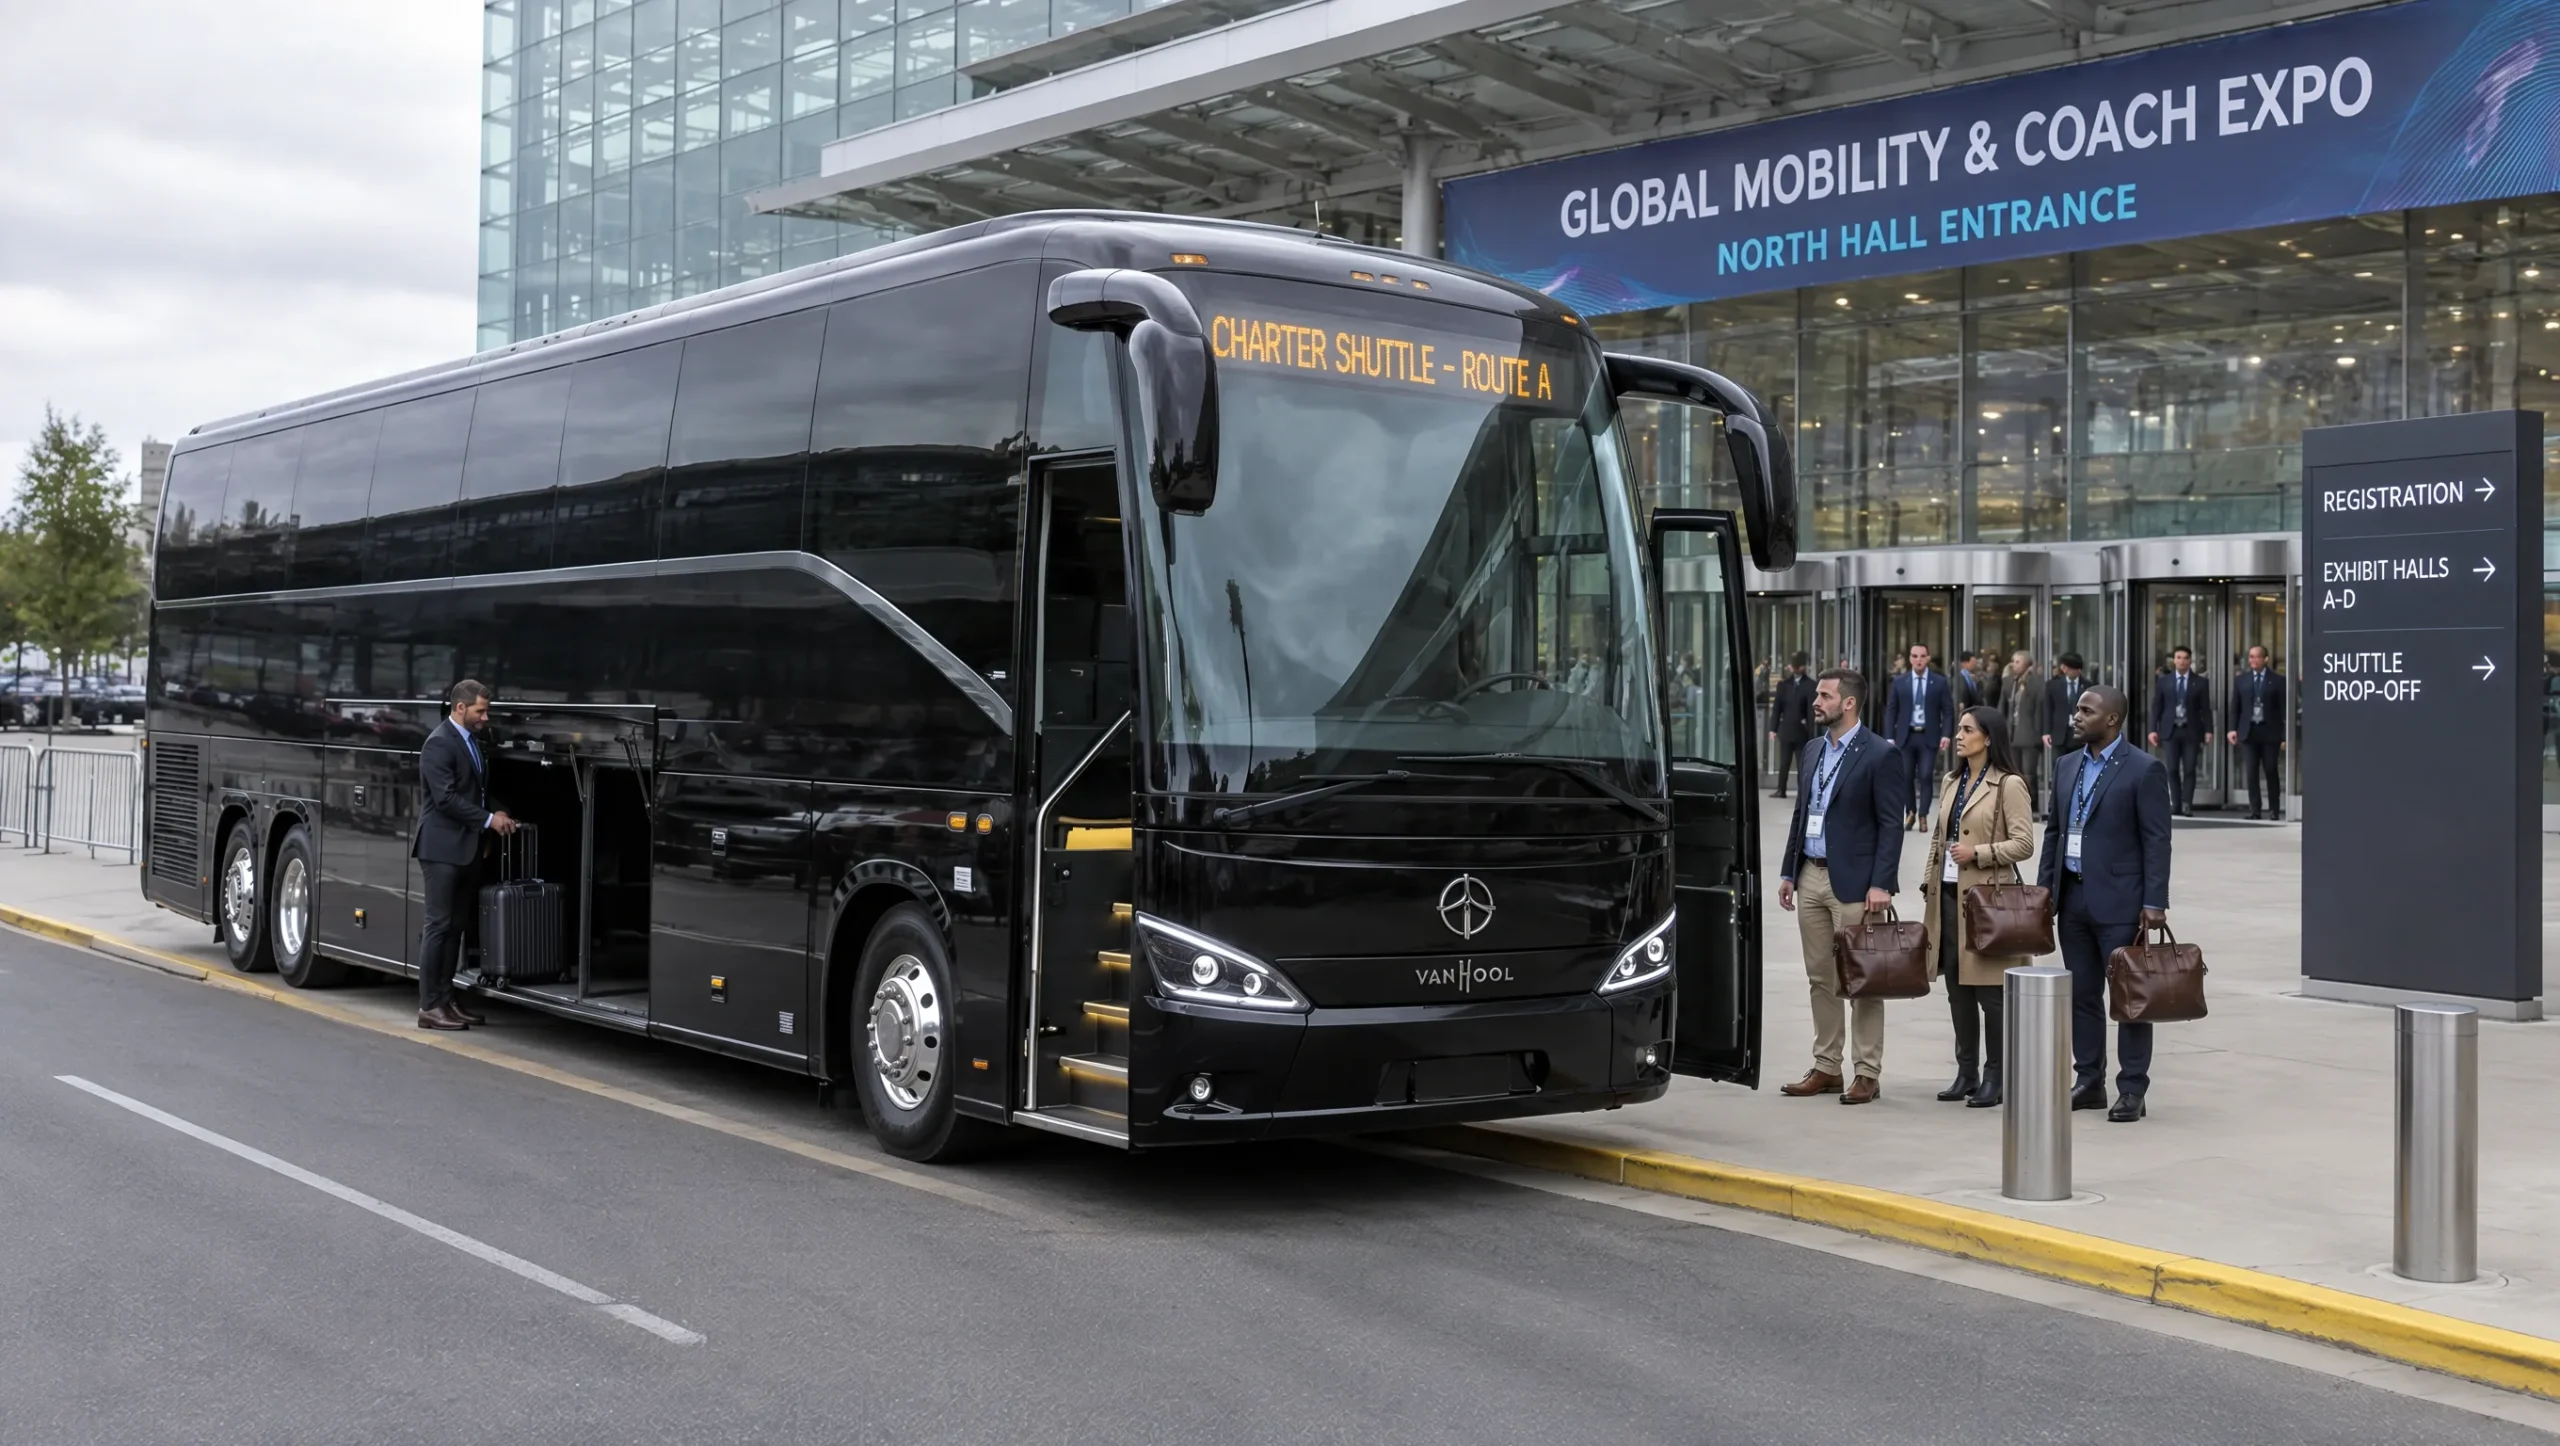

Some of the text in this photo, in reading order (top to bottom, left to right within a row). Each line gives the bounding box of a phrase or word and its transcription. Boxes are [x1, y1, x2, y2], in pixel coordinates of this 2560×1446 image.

[1559, 56, 2373, 239] GLOBAL MOBILITY & COACH EXPO
[1718, 183, 2138, 276] NORTH HALL ENTRANCE
[1212, 315, 1328, 371] CHARTER
[1335, 332, 1436, 385] SHUTTLE
[1462, 350, 1531, 397] ROUTE
[1537, 363, 1553, 400] A
[2323, 480, 2464, 512] REGISTRATION
[2323, 557, 2450, 582] EXHIBIT HALLS
[2322, 588, 2356, 610] A-D
[2323, 652, 2403, 674] SHUTTLE
[2324, 679, 2422, 701] DROP-OFF
